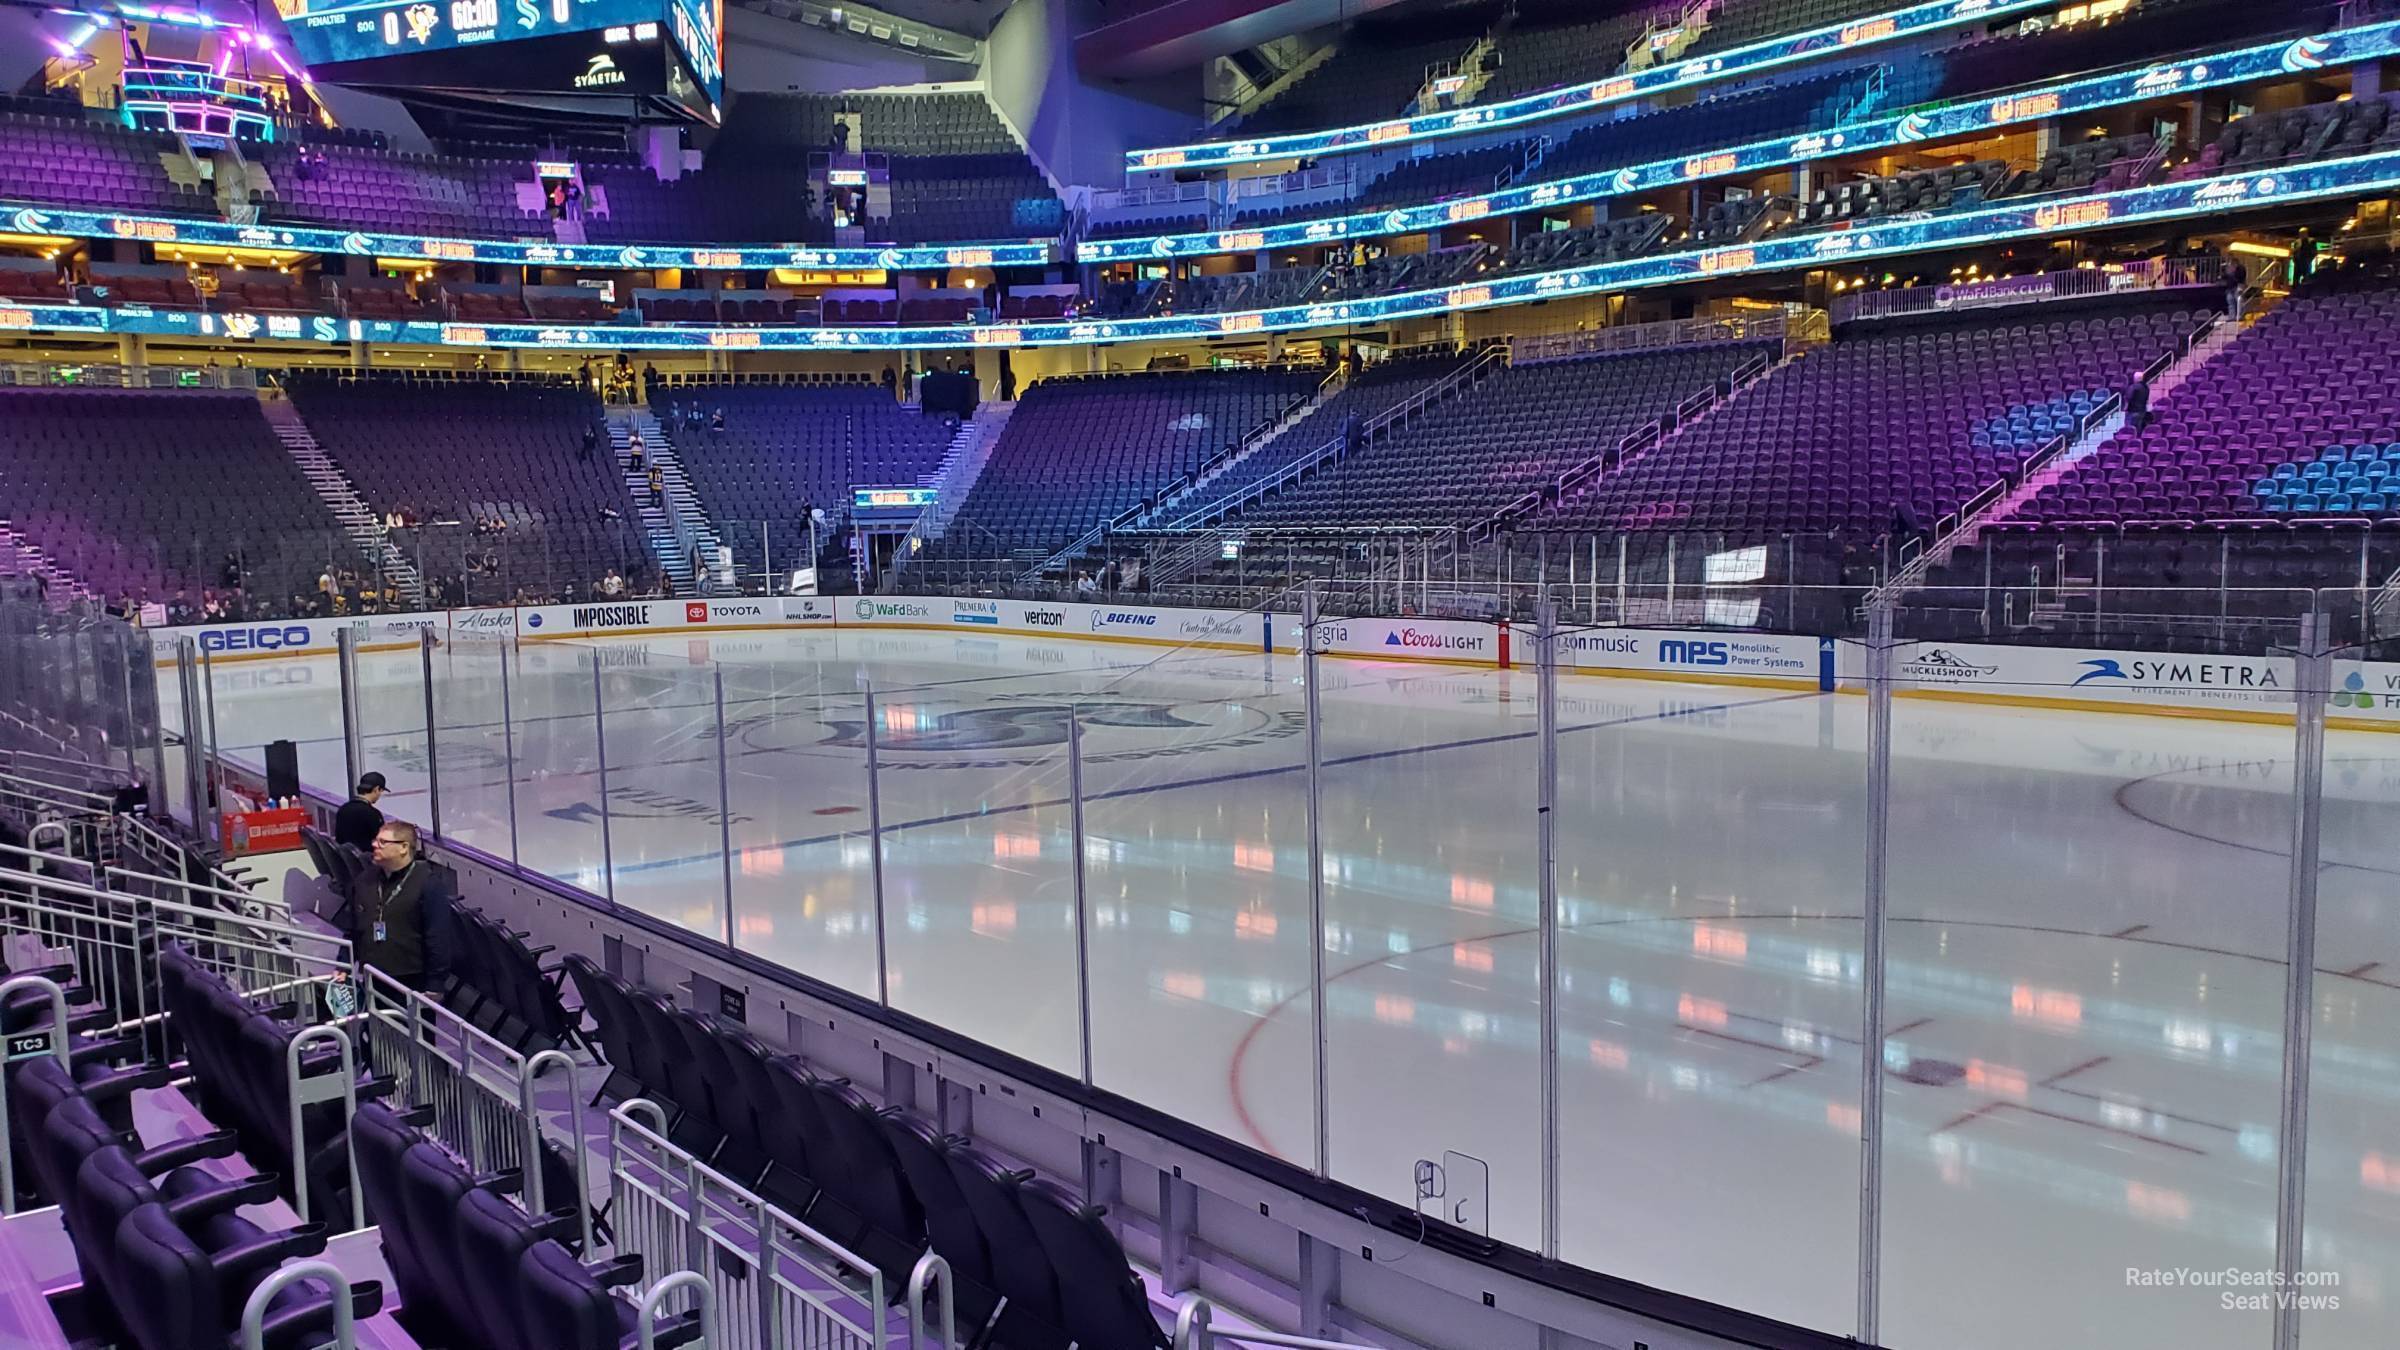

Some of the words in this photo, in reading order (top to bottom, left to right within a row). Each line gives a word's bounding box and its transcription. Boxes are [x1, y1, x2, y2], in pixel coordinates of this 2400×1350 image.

[307, 14, 346, 28] PENALTIES
[451, 0, 498, 30] 60:00
[357, 21, 375, 33] SOG
[384, 12, 399, 45] 0
[457, 30, 495, 43] PREGAME
[574, 71, 625, 87] SYMETRA
[2061, 202, 2109, 223] FIREBIRDS
[2020, 283, 2053, 295] CLUB
[712, 606, 761, 617] TOYOTA
[954, 600, 987, 613] PREMERA
[458, 612, 513, 629] Alaska
[573, 605, 650, 628] IMPOSSIBLE
[1024, 609, 1063, 626] verizon
[1107, 613, 1156, 626] BOEING
[199, 626, 310, 651] GEICO
[1311, 623, 1348, 645] egria
[1402, 628, 1443, 648] Coors
[1445, 636, 1484, 650] LIGHT
[1590, 634, 1639, 653] music
[1731, 643, 1780, 654] Monolithic
[1731, 655, 1761, 665] Power
[1764, 657, 1804, 668] Systems
[1902, 666, 1979, 678] MUCKLESHOOT
[2132, 661, 2279, 687] SYMETRA
[2201, 691, 2249, 700] BENEFITS
[14, 1038, 44, 1052] TC3
